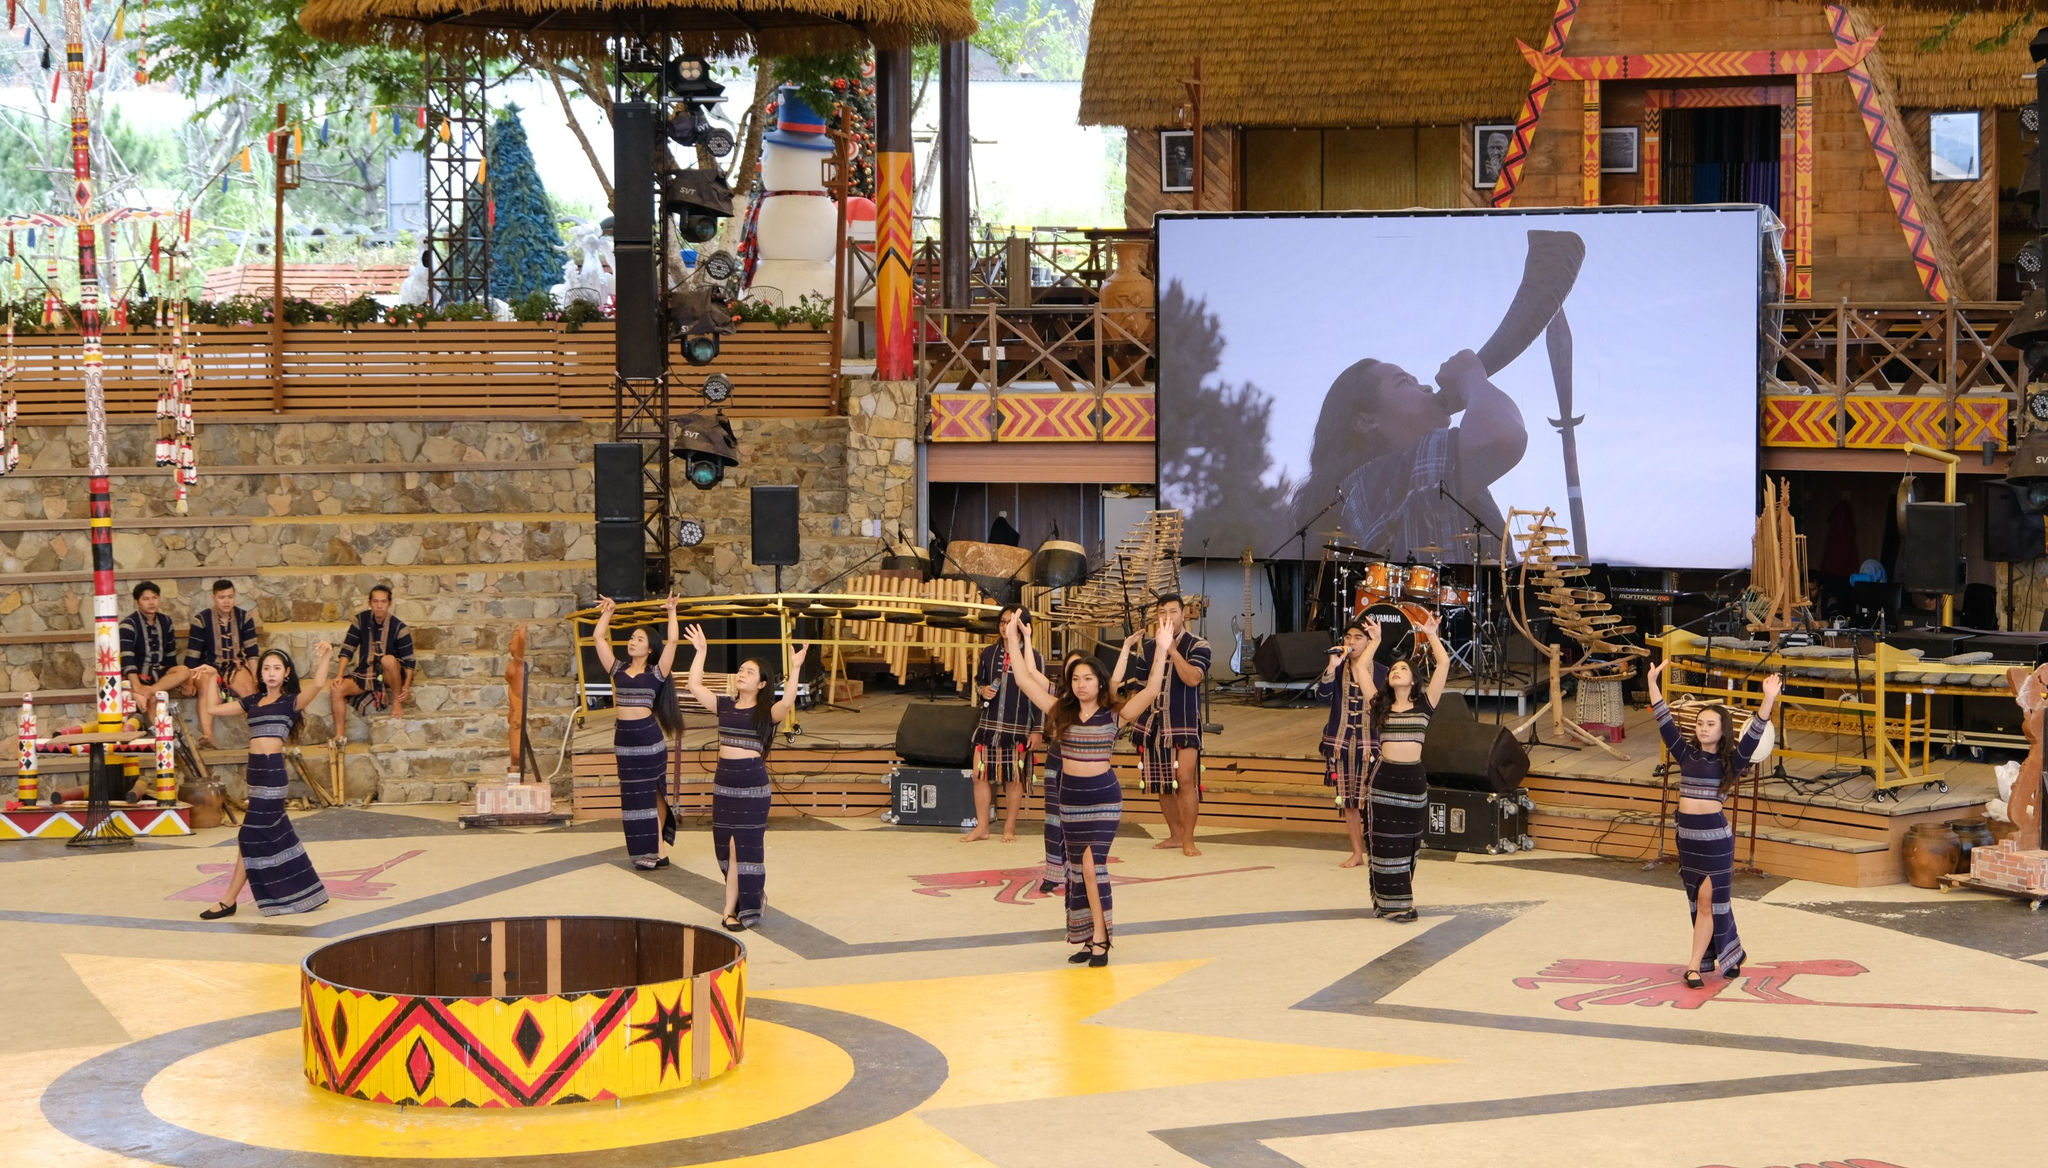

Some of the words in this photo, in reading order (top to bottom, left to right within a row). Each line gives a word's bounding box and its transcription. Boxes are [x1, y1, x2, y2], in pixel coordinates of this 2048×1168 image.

[679, 187, 696, 195] SVT
[2034, 310, 2047, 319] SV
[683, 430, 700, 439] SVT
[2035, 455, 2048, 464] SV
[1376, 614, 1401, 623] YAMAHA
